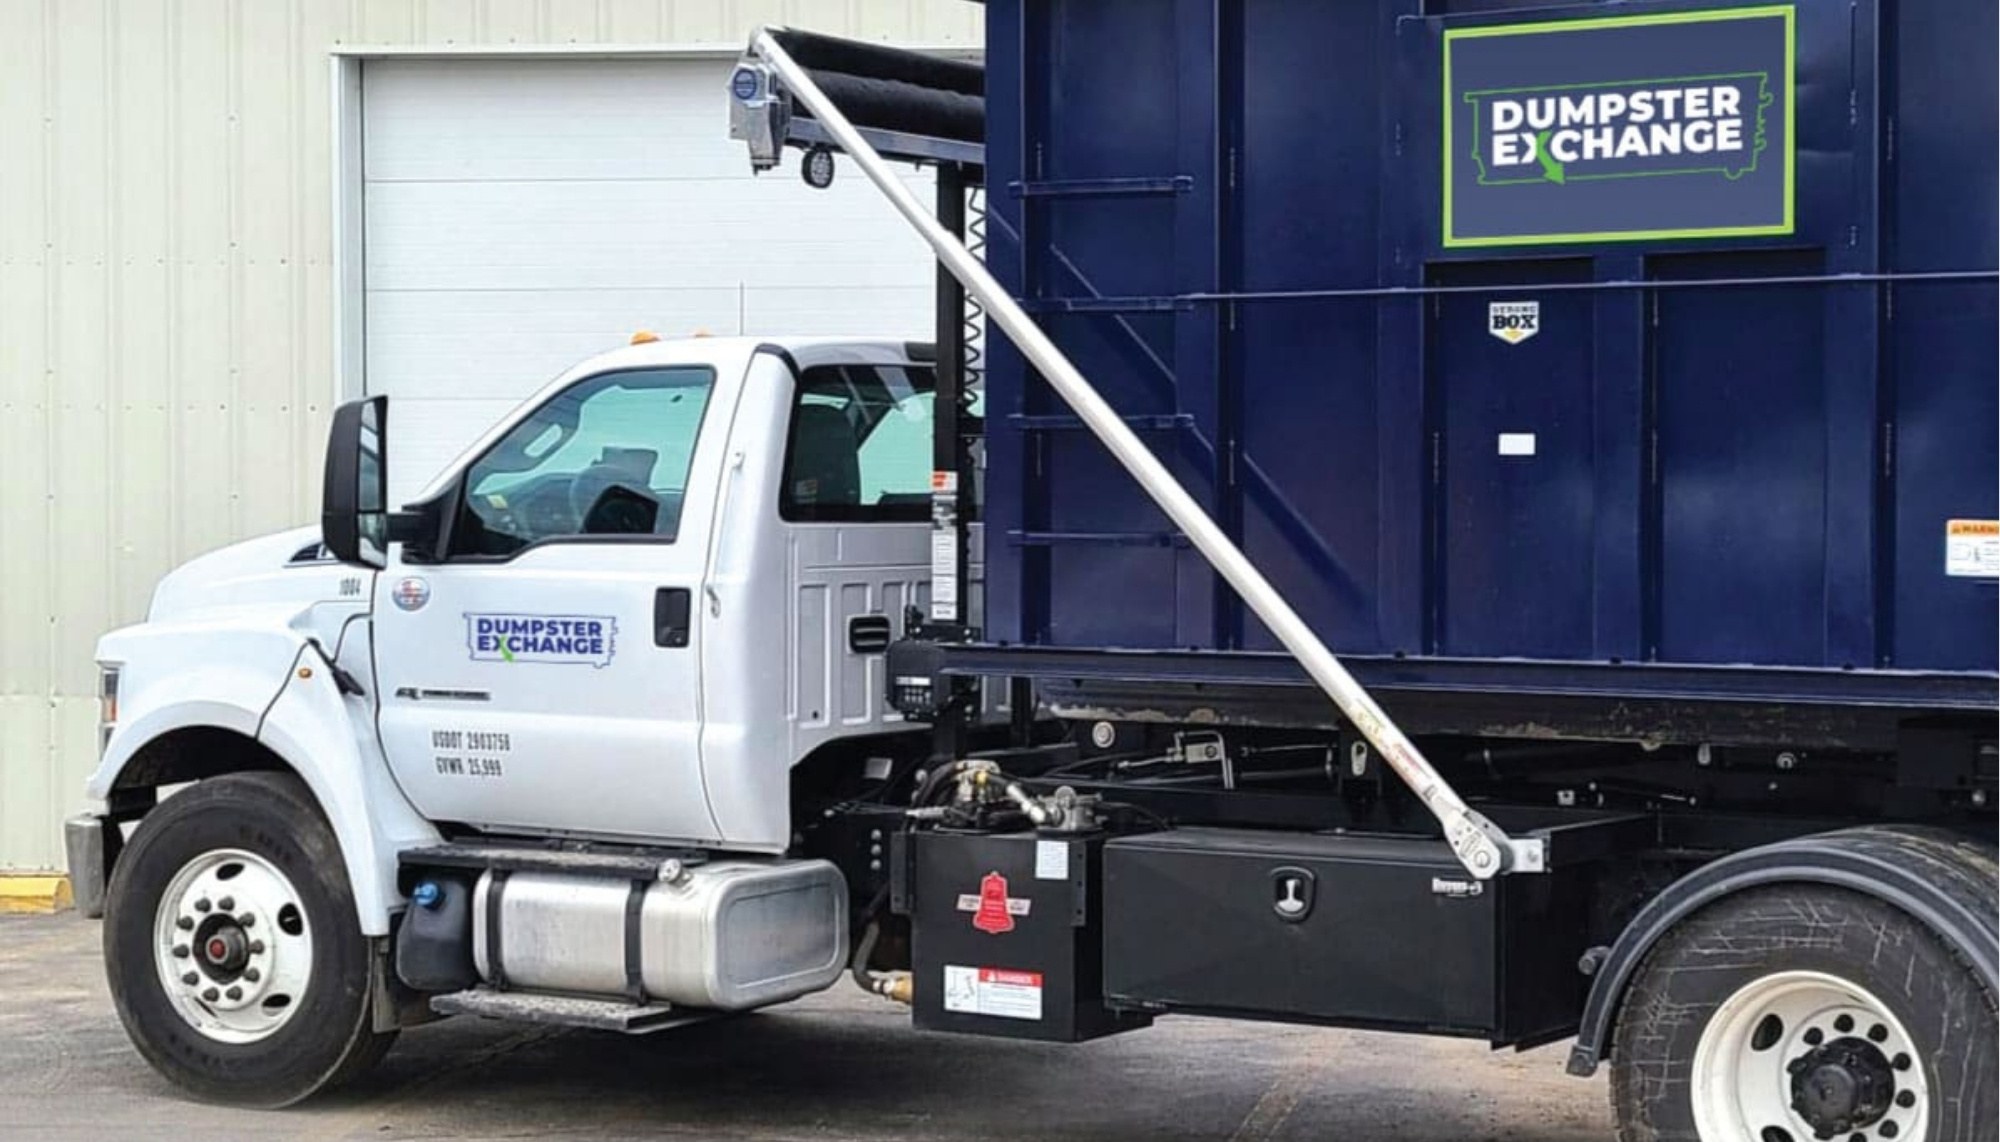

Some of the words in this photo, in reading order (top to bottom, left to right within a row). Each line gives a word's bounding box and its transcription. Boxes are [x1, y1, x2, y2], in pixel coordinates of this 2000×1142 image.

[1492, 85, 1741, 132] DUMPSTER
[1492, 118, 1744, 168] EXCHANGE
[1493, 315, 1536, 329] BOX
[477, 618, 603, 637] DUMPSTER
[477, 635, 604, 655] EXCHANGE
[432, 730, 462, 748] USDOT
[435, 756, 464, 774] GVWR
[468, 757, 502, 776] 25,999
